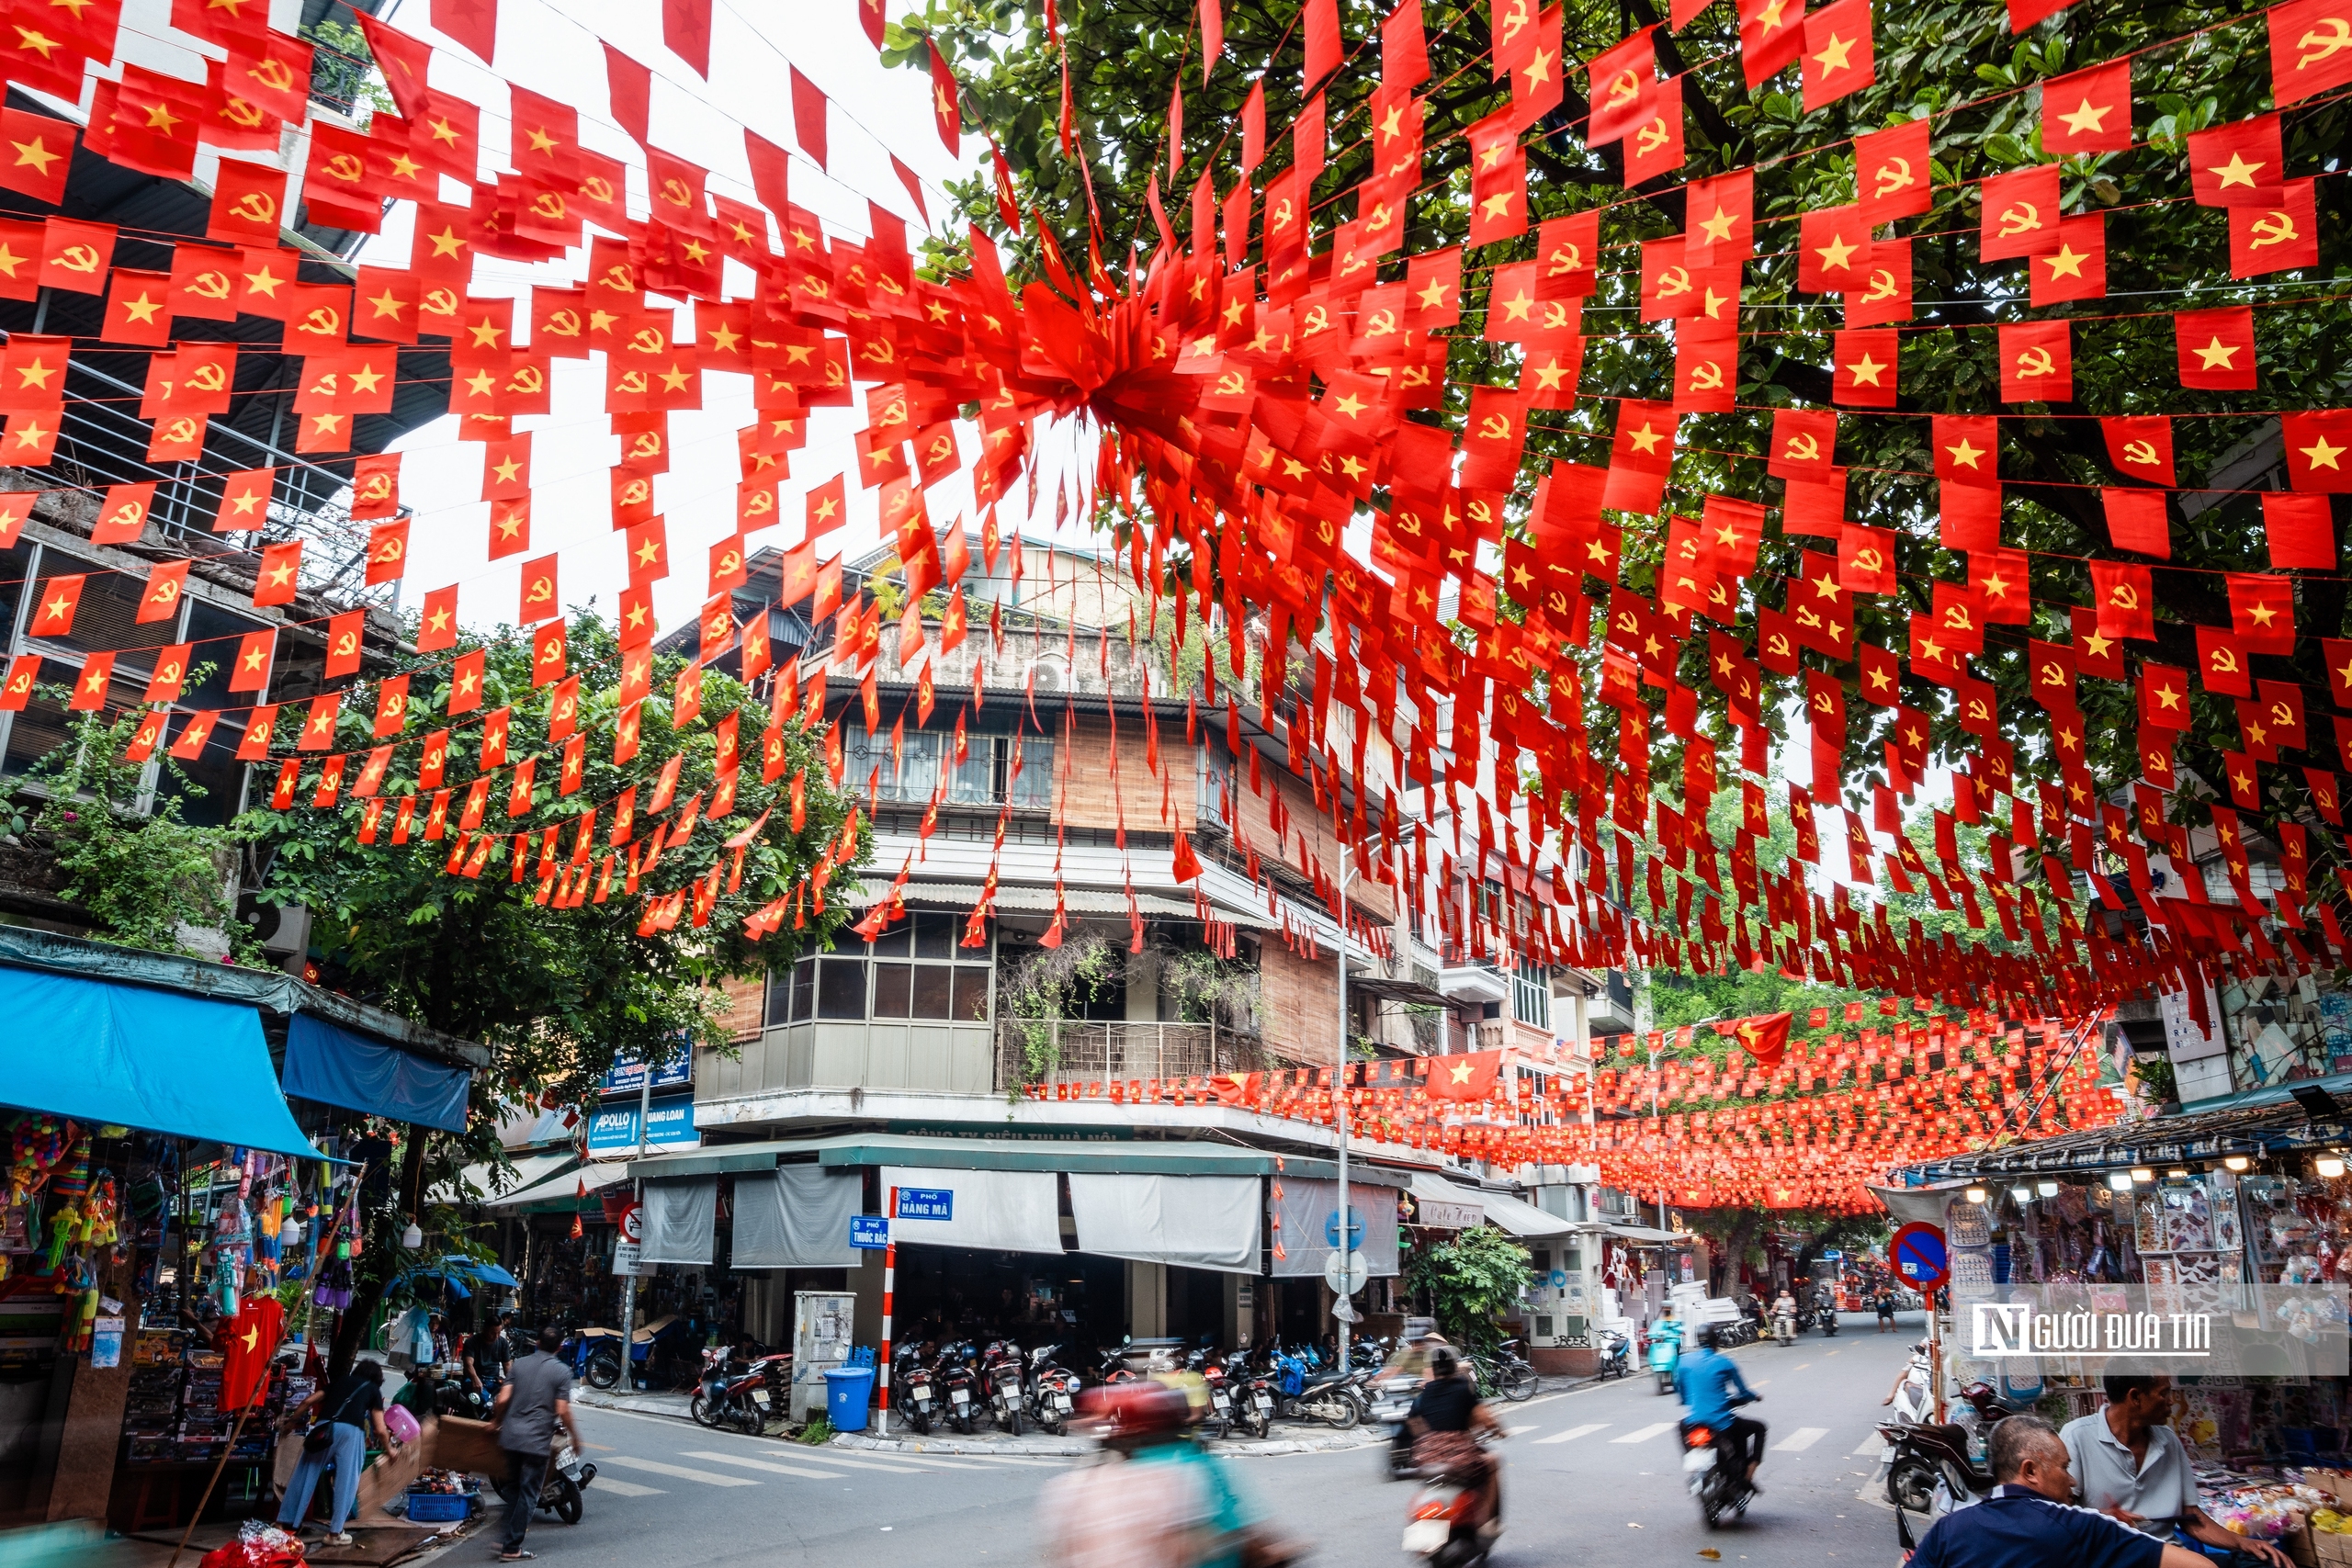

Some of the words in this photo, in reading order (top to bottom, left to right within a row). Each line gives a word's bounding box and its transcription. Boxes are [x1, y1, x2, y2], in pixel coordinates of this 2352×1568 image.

[594, 1111, 630, 1133] APOLLO
[647, 1110, 666, 1123] UANG
[666, 1109, 684, 1122] LOAN
[902, 1201, 929, 1214] HÀNG
[933, 1203, 947, 1215] MÃ
[866, 1220, 879, 1228] PHỐ
[854, 1230, 874, 1244] THUỐC
[875, 1229, 887, 1244] BẮC
